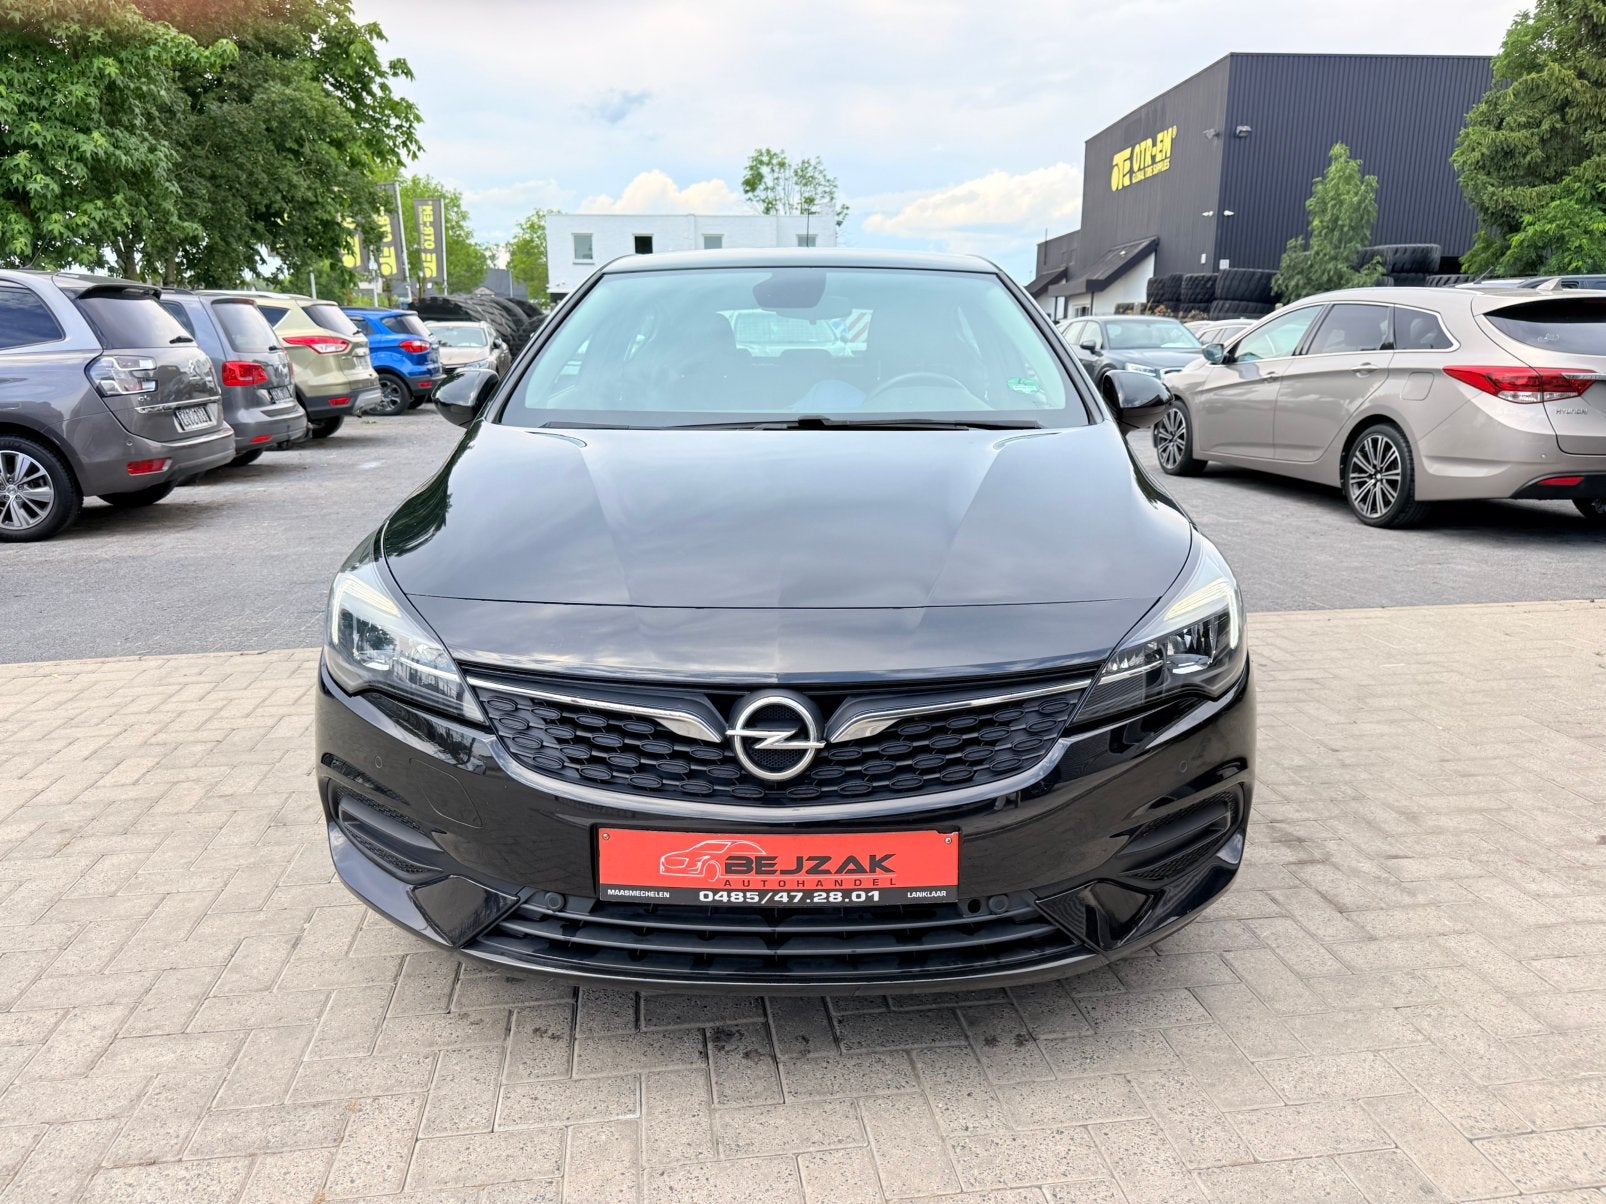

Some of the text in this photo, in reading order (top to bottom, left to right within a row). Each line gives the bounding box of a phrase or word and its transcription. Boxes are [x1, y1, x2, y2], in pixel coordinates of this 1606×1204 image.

[724, 853, 896, 876] BEJZAK
[723, 878, 897, 888] AUTOHANDEL
[607, 888, 670, 898] MAASMECHELEN
[699, 890, 880, 904] 0485/47.28.01
[907, 890, 947, 898] LANKLAAR
